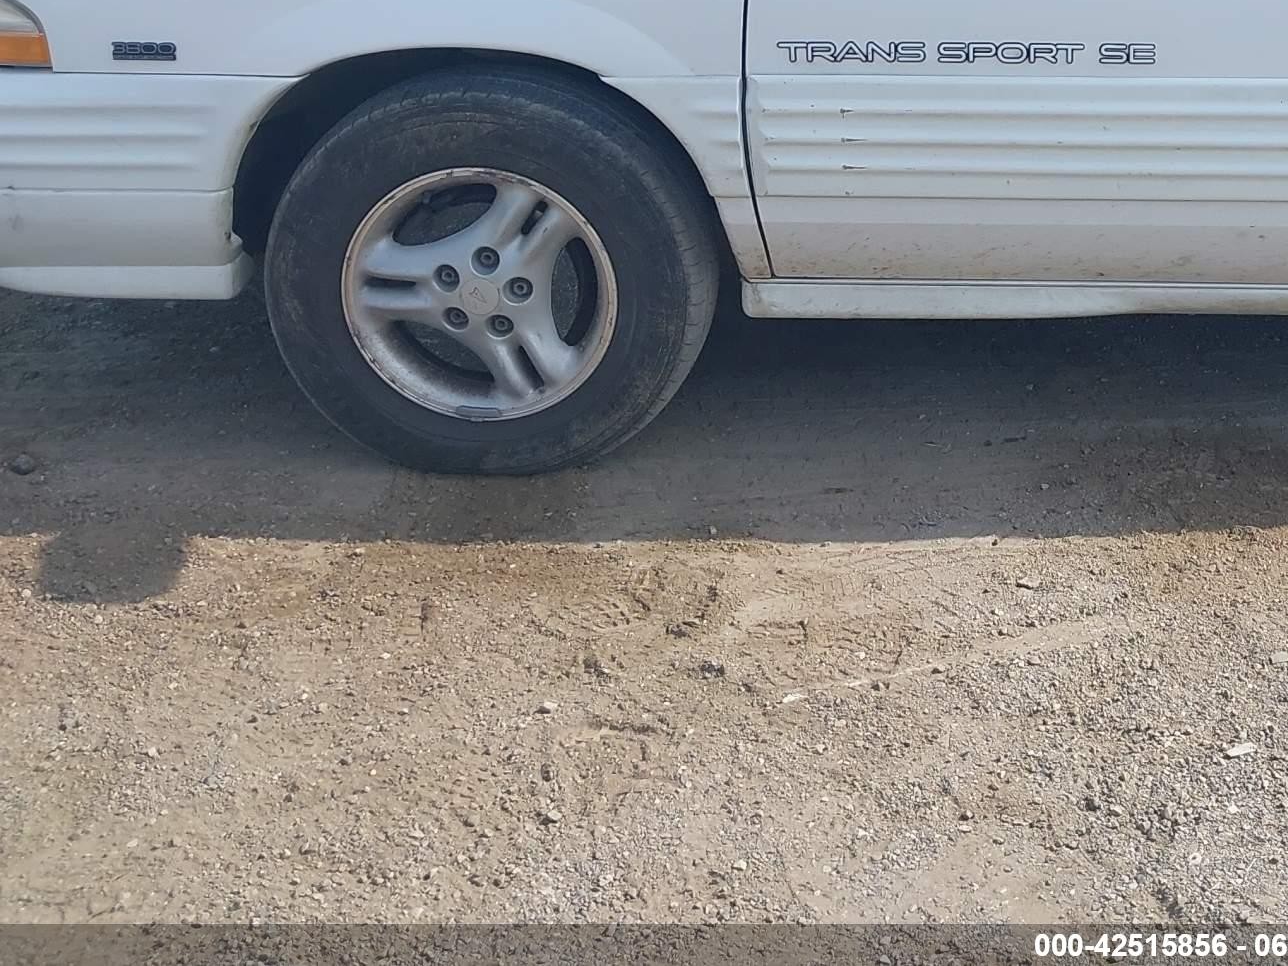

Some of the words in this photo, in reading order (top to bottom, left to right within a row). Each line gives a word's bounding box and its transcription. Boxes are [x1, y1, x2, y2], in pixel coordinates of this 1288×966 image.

[111, 41, 177, 55] 3800
[777, 41, 926, 63] TRANS
[937, 42, 1085, 64] SPORT
[1099, 43, 1156, 65] SE
